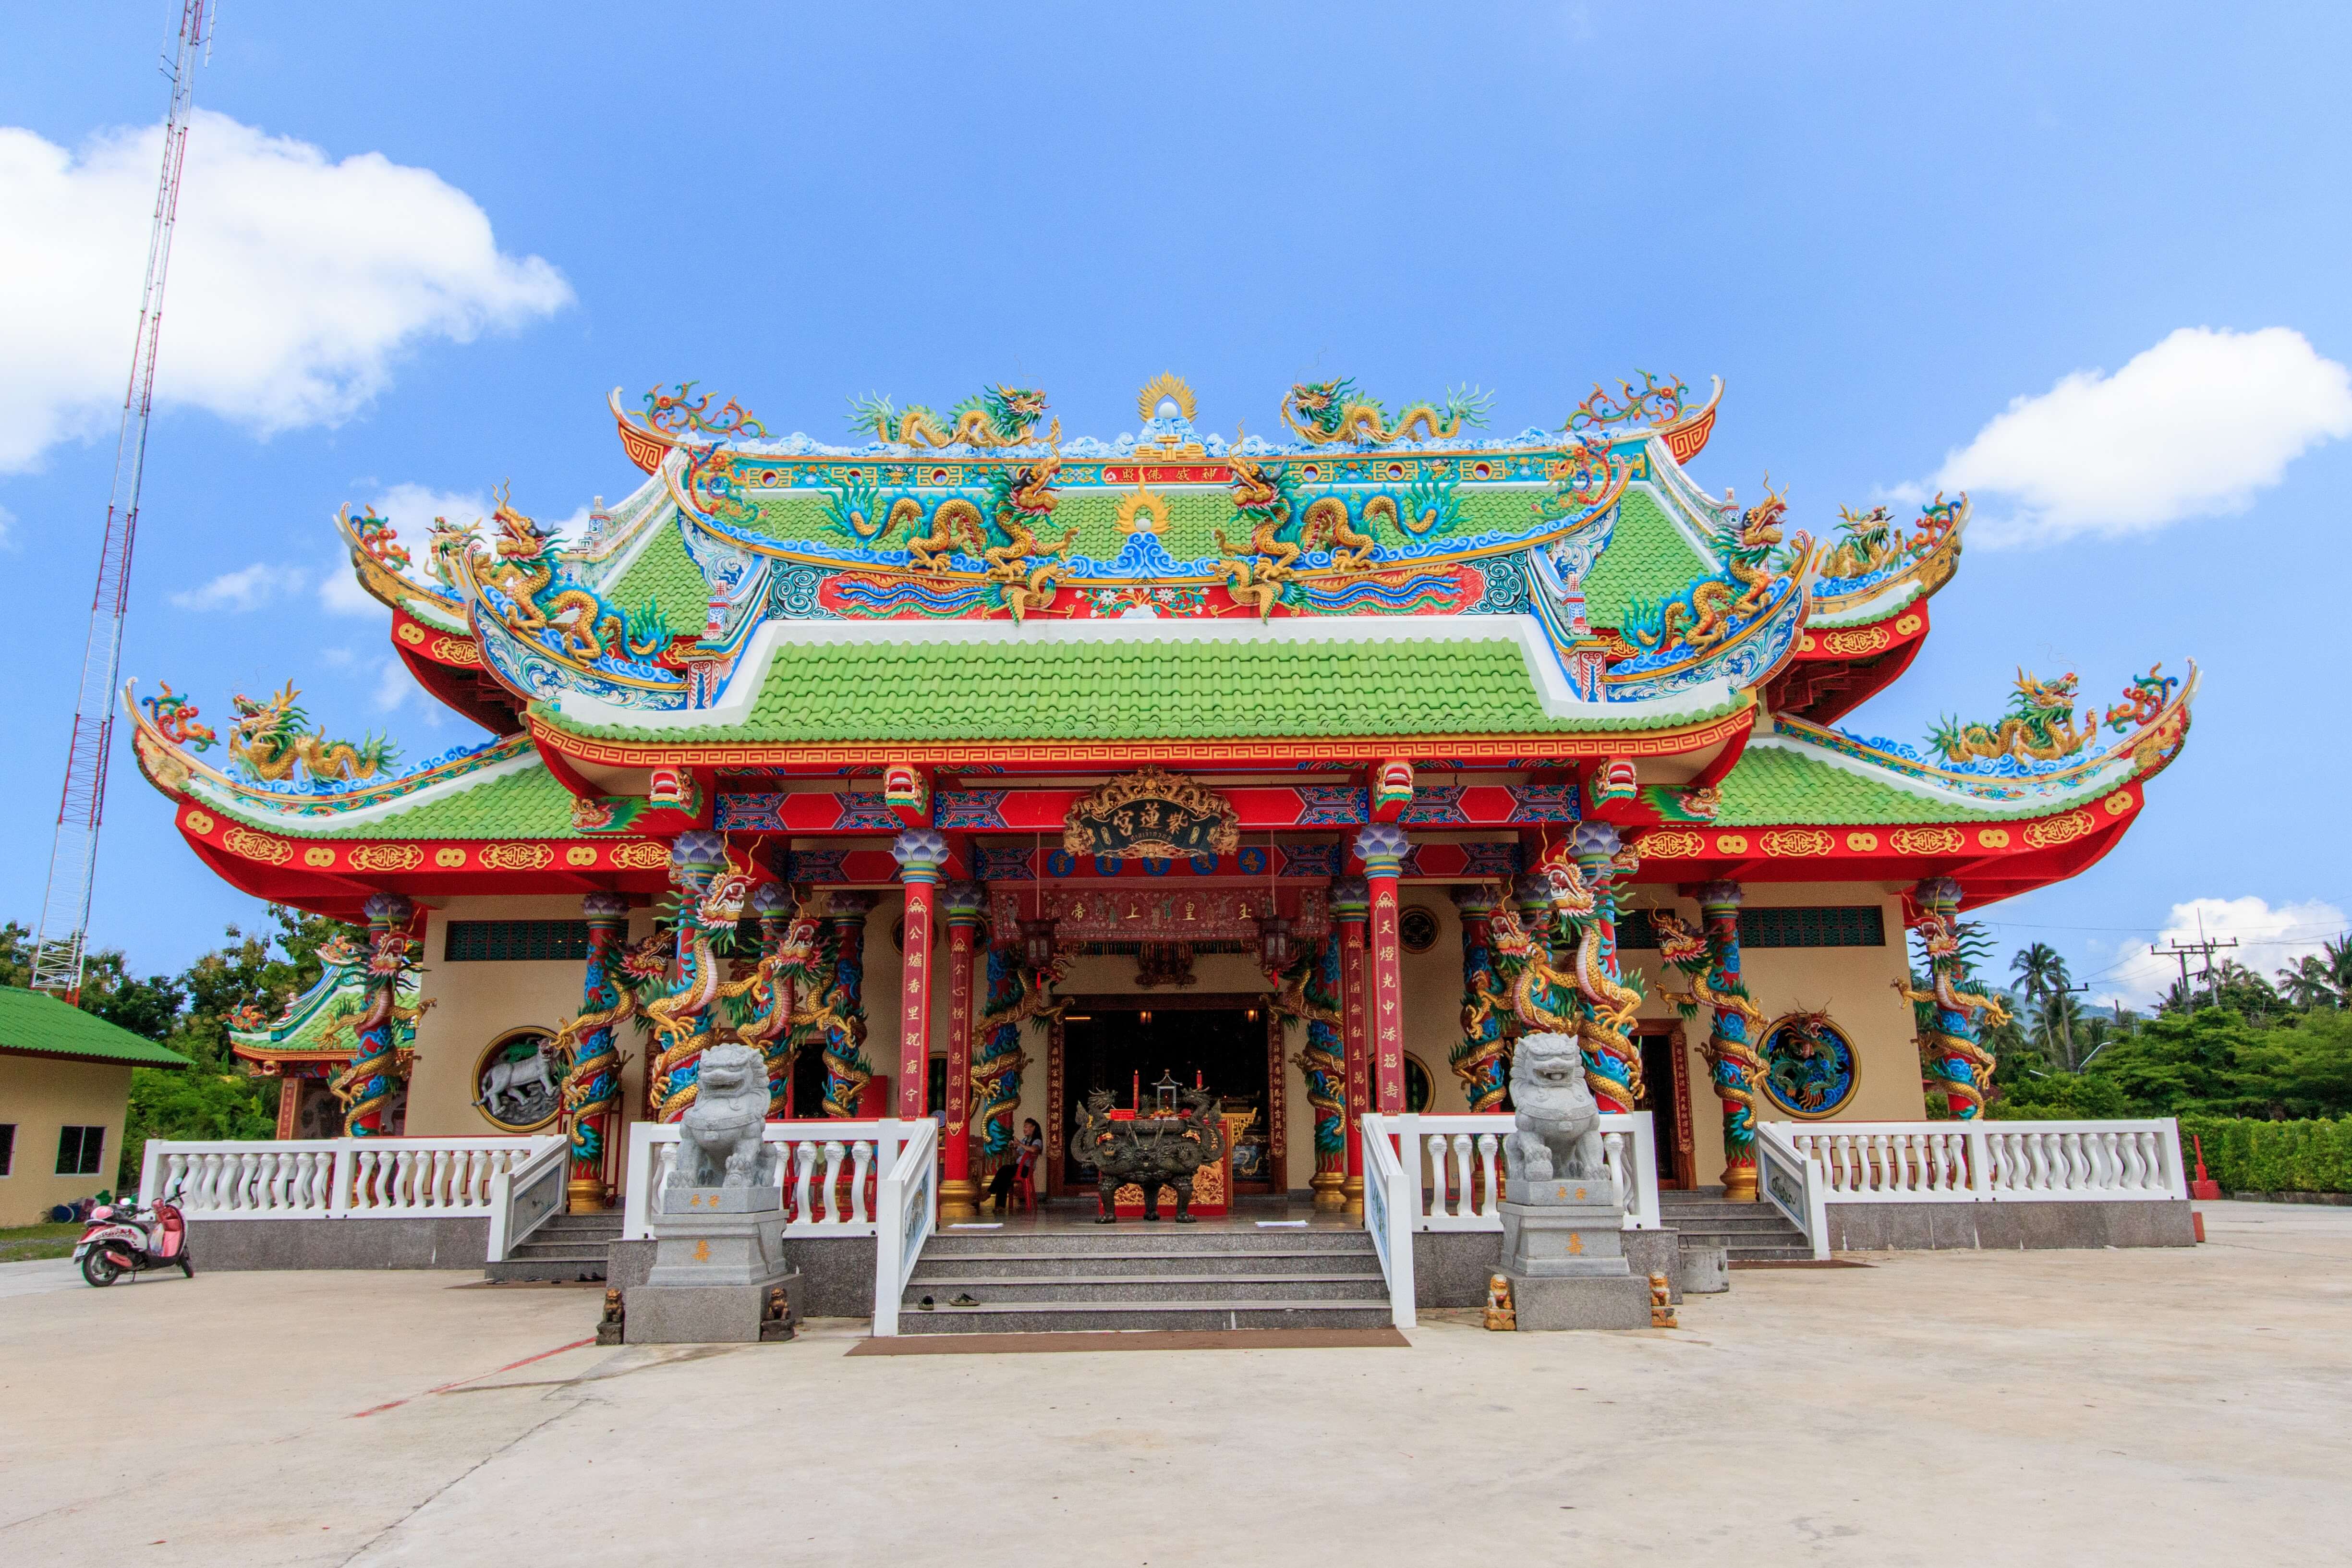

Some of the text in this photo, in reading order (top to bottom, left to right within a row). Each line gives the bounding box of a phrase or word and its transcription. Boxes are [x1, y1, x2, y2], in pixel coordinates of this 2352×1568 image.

[1113, 802, 1188, 836] 紫蓮宮
[1071, 900, 1252, 922] 玉皇上帝
[1379, 919, 1399, 1098] 天燈光中添福壽
